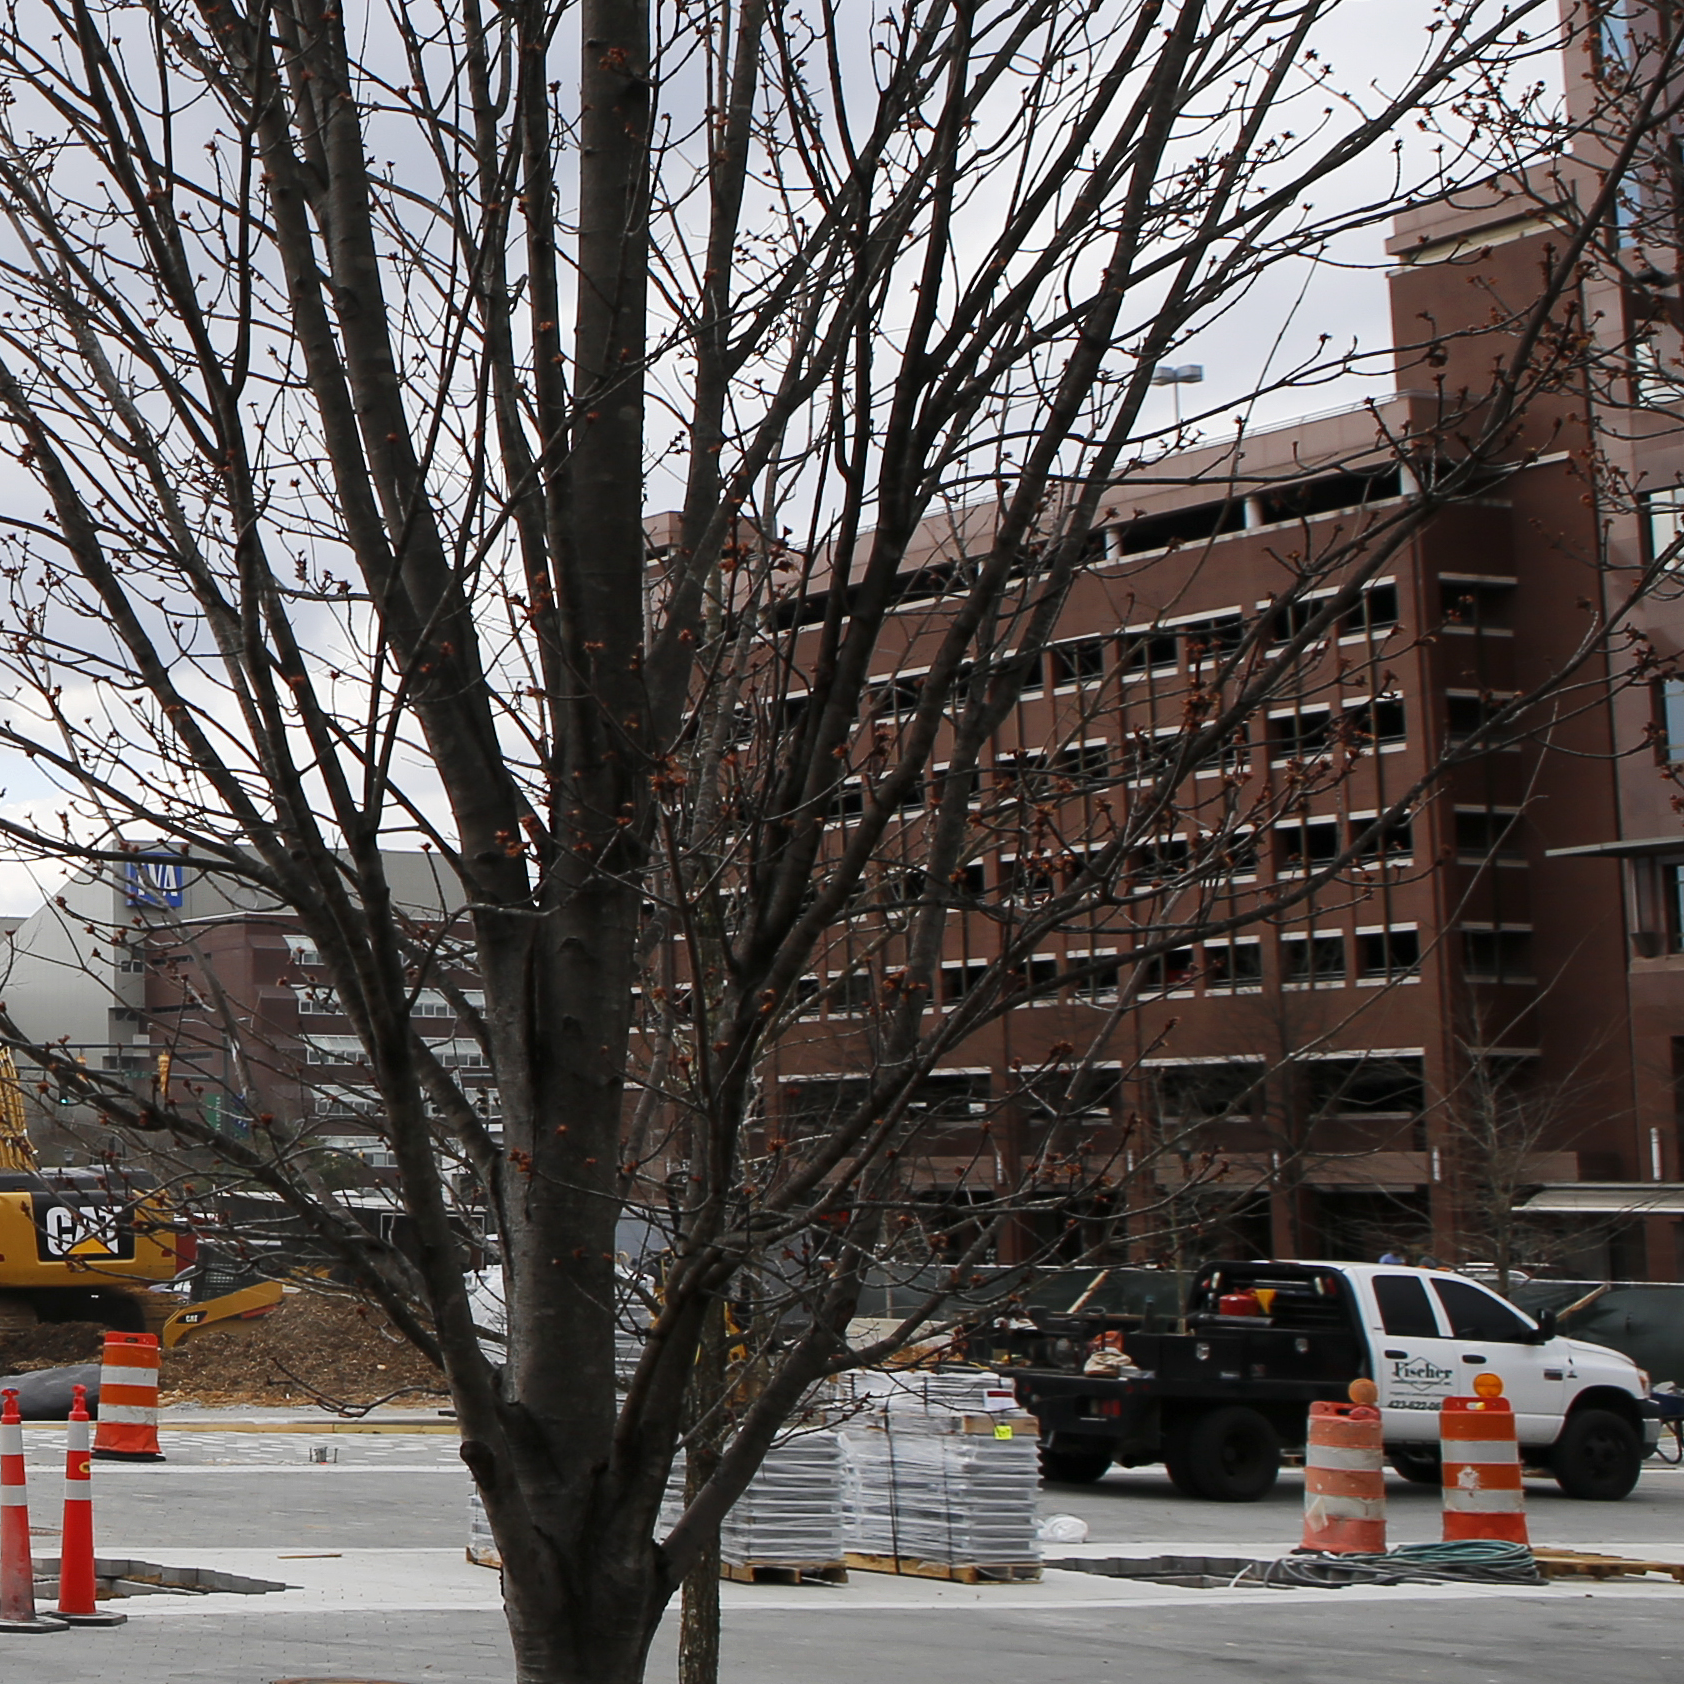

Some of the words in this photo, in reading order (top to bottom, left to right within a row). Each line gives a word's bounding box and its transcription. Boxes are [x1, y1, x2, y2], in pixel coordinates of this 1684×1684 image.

[46, 1206, 123, 1255] CAT
[185, 1314, 199, 1323] CAT
[1394, 1362, 1452, 1378] Fischer
